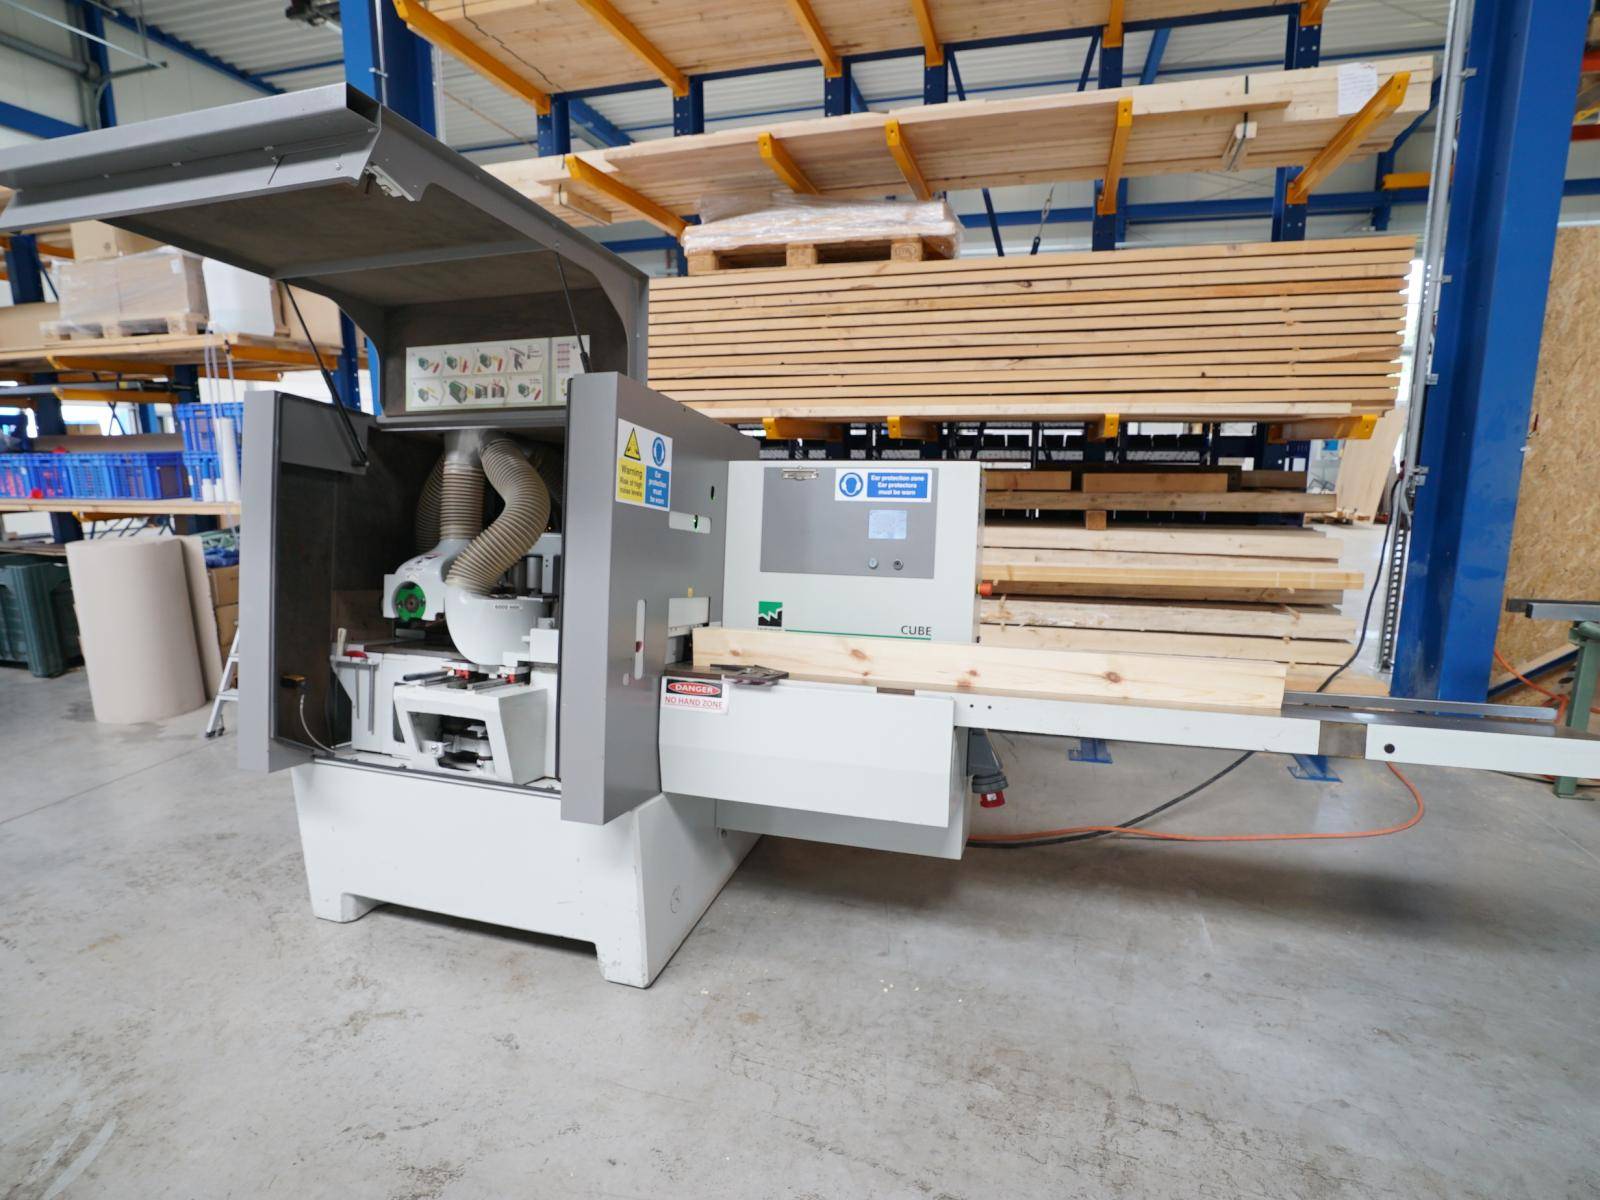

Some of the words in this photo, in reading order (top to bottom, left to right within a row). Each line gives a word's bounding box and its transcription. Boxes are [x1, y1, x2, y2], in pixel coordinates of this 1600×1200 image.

[622, 464, 642, 480] Warning
[870, 474, 880, 482] Ear
[878, 481, 887, 489] Ear
[901, 625, 932, 636] CUBE
[675, 684, 713, 693] DANGER
[678, 697, 701, 706] HAND
[703, 700, 721, 708] ZONE
